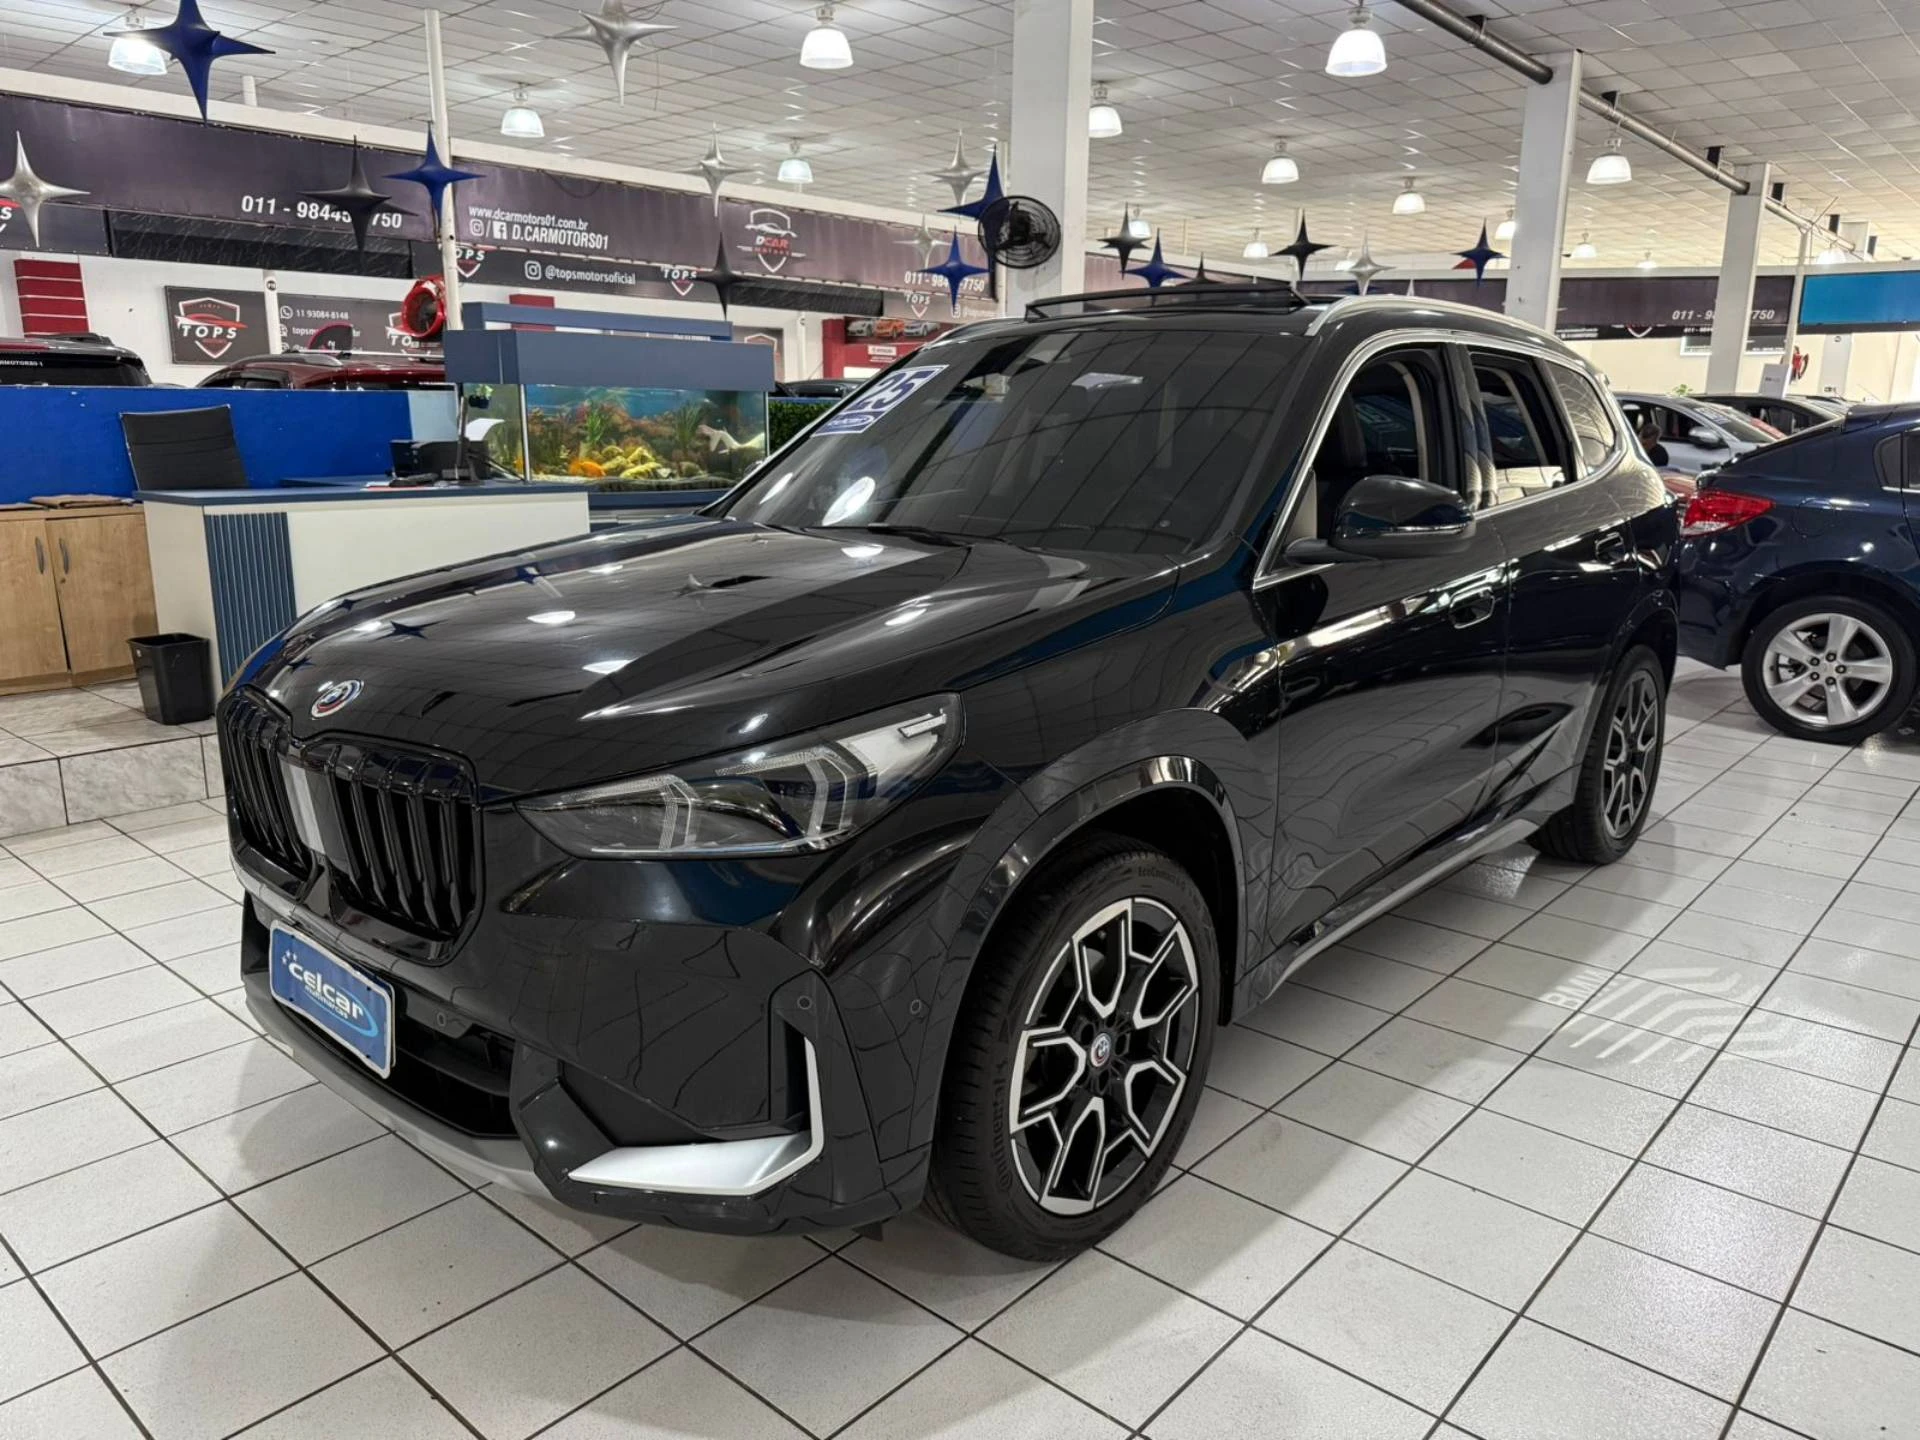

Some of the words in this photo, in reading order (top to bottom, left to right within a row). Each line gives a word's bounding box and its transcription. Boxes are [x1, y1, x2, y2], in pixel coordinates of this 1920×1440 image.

[241, 195, 276, 215] 011
[468, 206, 589, 230] www.dcarmotors01.com.br
[511, 224, 609, 250] D.CARMOTORS01
[544, 265, 636, 285] @topsmotorsoficial
[904, 270, 923, 285] 011
[905, 293, 931, 305] TOPS
[296, 309, 305, 317] 11
[1671, 309, 1694, 320] 011
[181, 325, 237, 339] TOPS
[288, 960, 364, 1020] celcar
